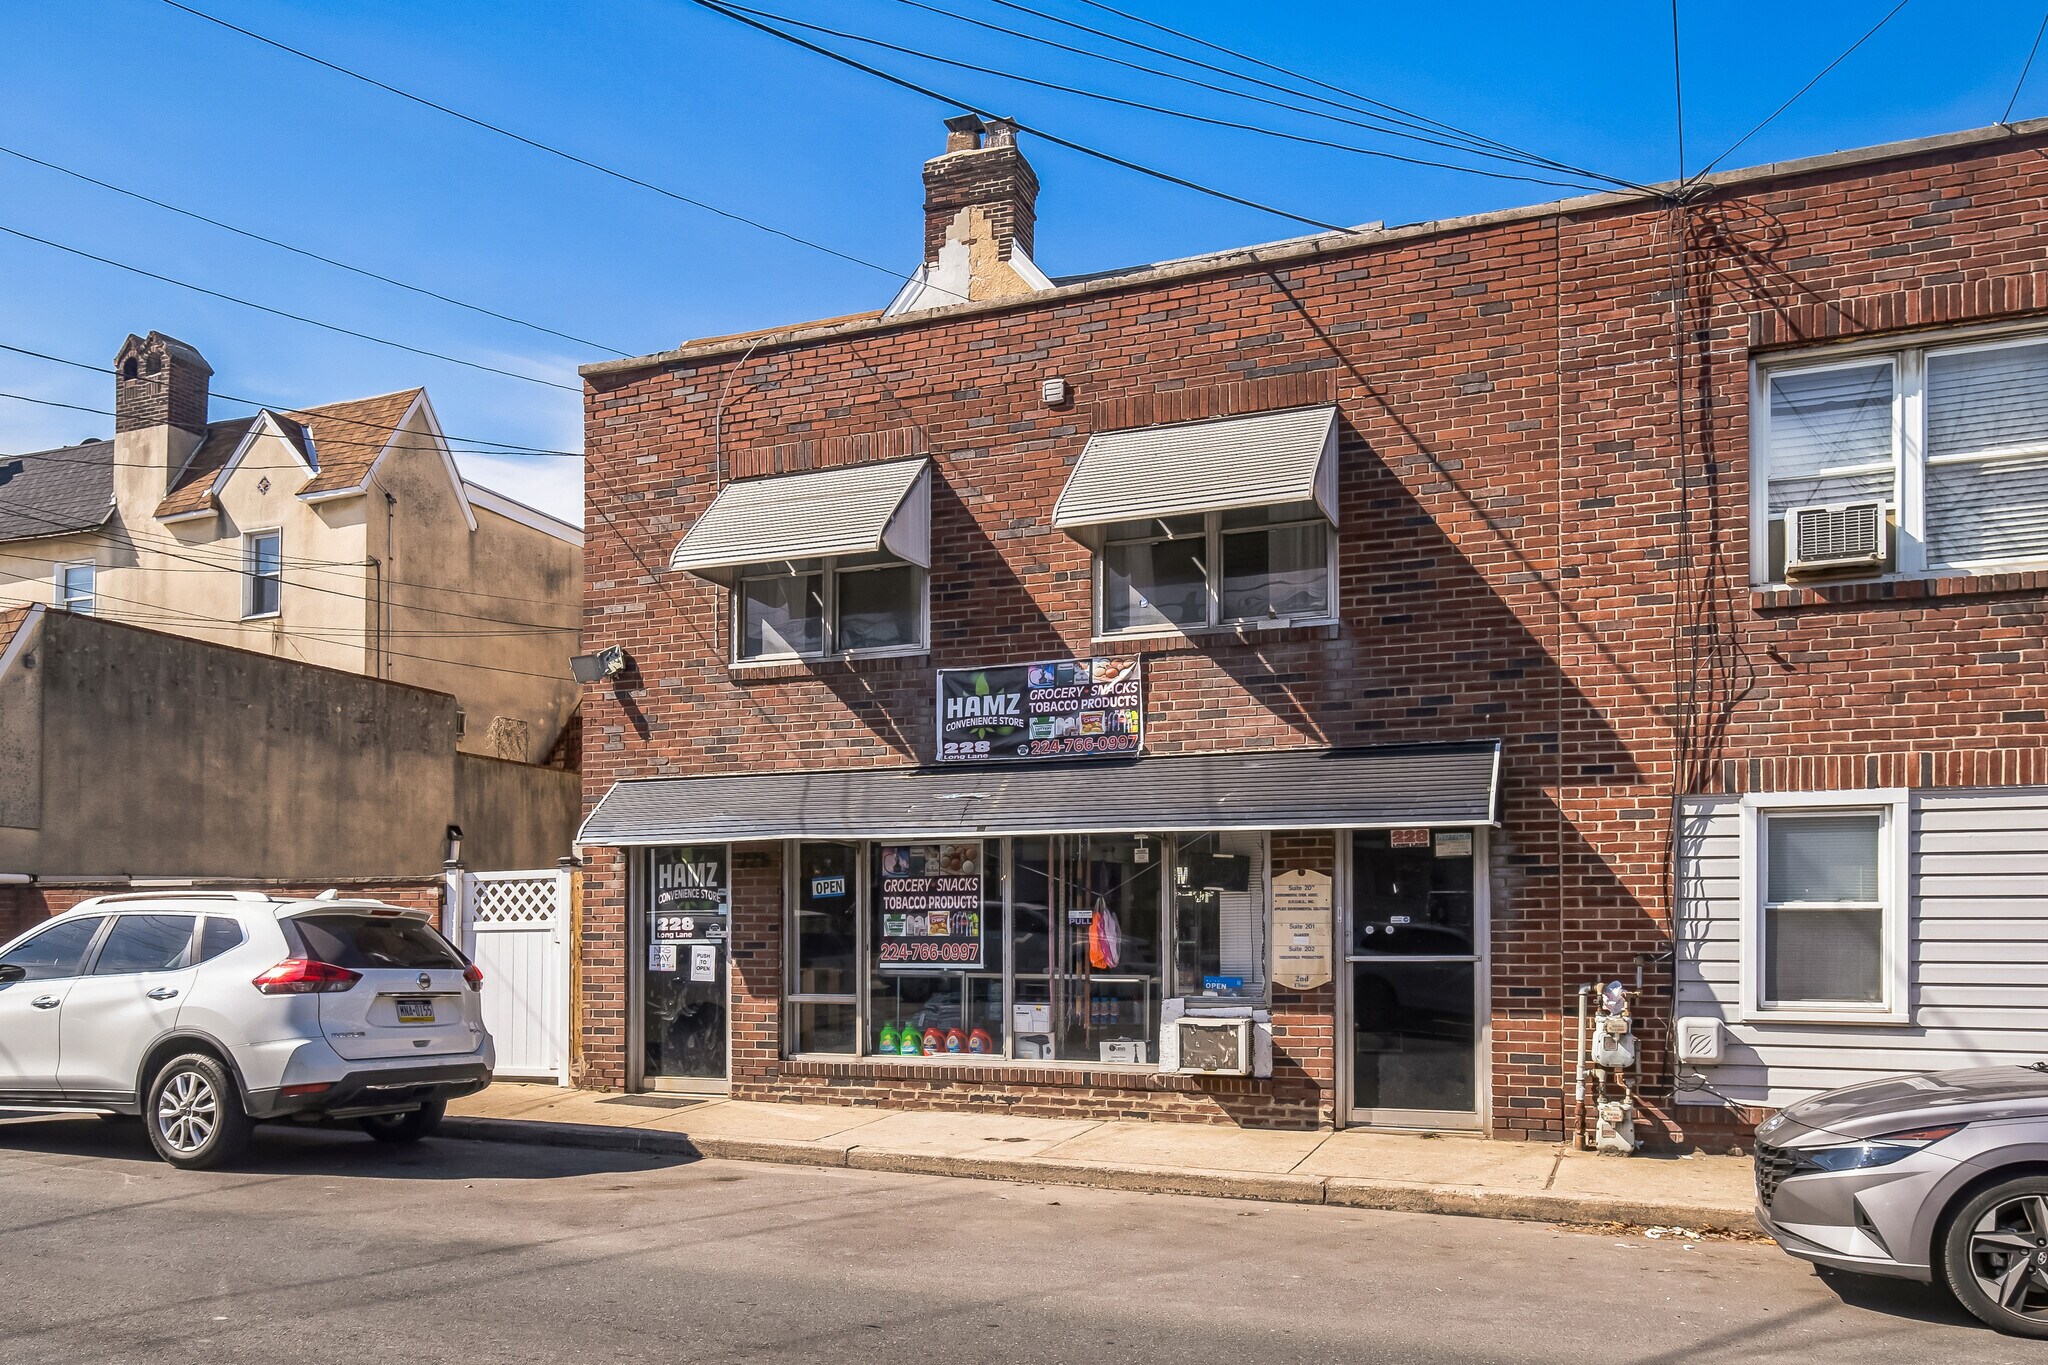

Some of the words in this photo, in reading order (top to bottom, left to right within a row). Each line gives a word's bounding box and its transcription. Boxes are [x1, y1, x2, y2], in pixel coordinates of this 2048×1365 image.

[1029, 686, 1085, 701] GROCERY
[1090, 682, 1139, 696] SNACKS
[947, 693, 1021, 719] HAMZ
[1029, 699, 1078, 714] TOBACCO
[1081, 695, 1138, 710] PRODUCTS
[946, 717, 998, 732] CONVENIENCE
[999, 717, 1024, 728] STORE
[944, 741, 990, 754] 228
[1030, 735, 1139, 755] 224-766-0997
[1392, 829, 1429, 843] 228
[658, 862, 717, 888] HAMZ
[816, 880, 843, 894] OPEN
[884, 878, 932, 893] GROCERY
[936, 877, 978, 892] SNACKS
[658, 888, 700, 905] CONVENIENCE
[700, 889, 721, 903] STORE
[883, 896, 926, 910] TOBACCO
[928, 895, 978, 909] PRODUCTS
[657, 916, 694, 931] 228
[653, 954, 671, 962] PAY
[880, 943, 979, 961] 224-766-0997
